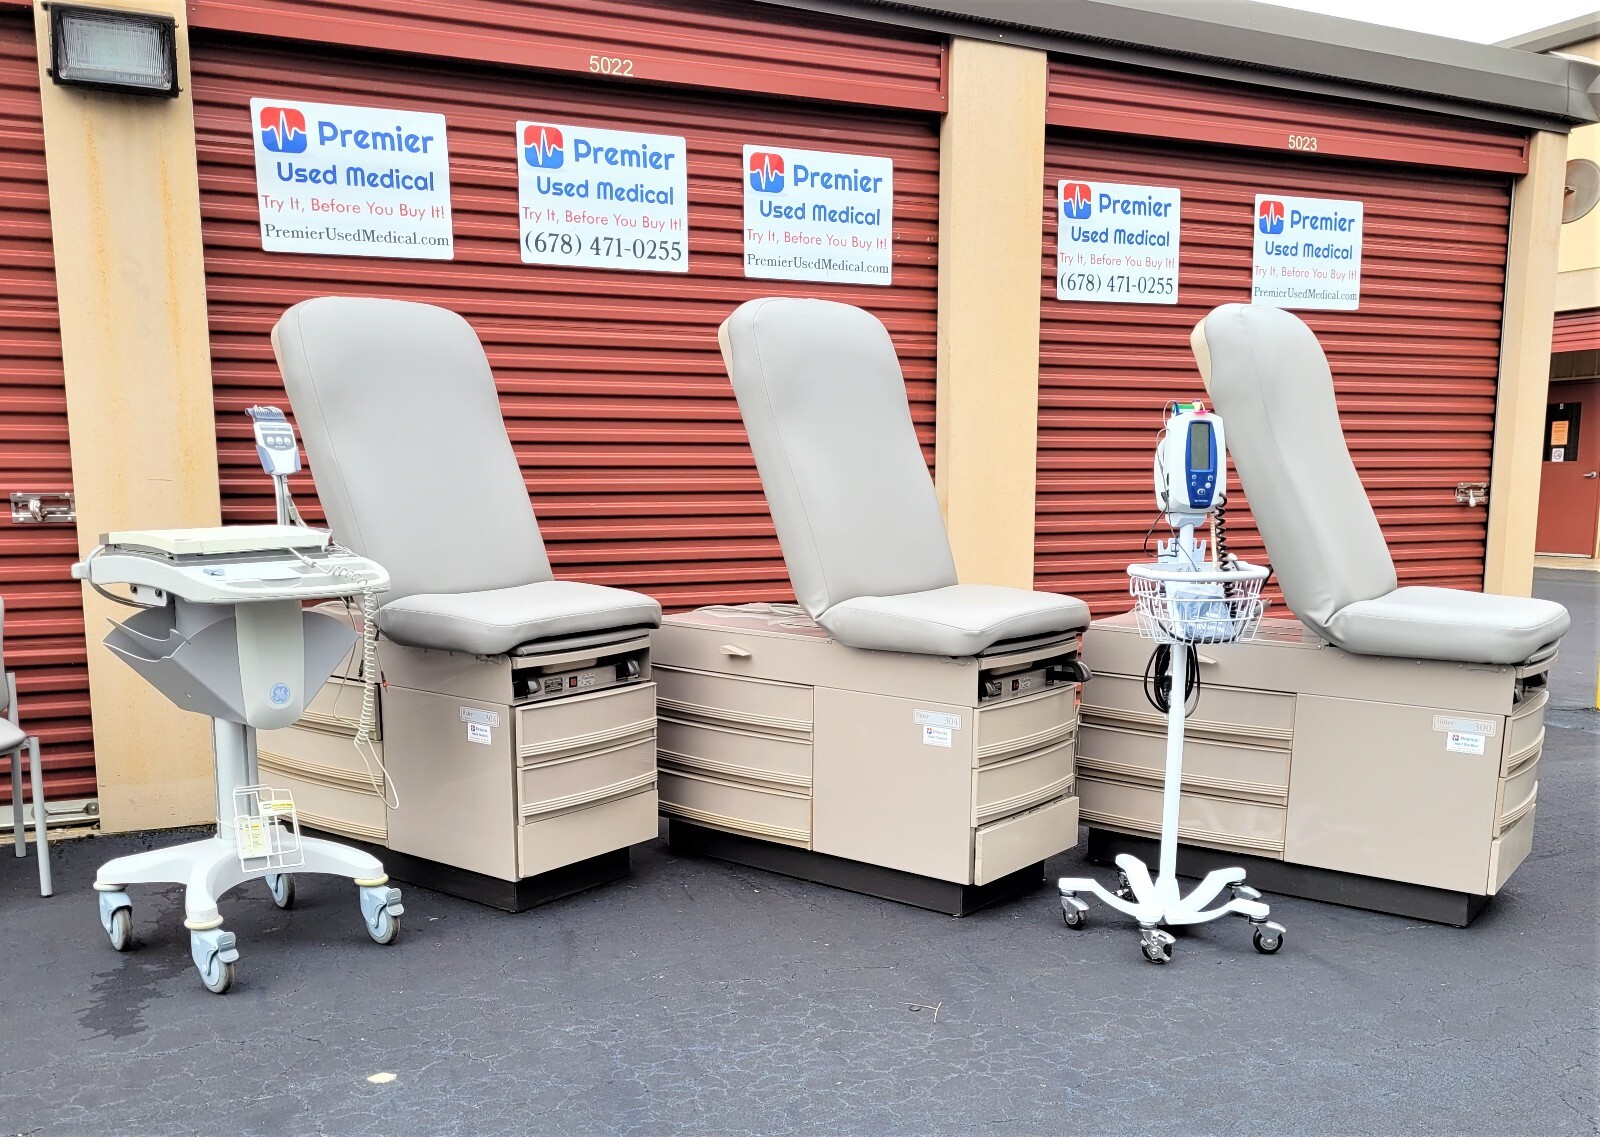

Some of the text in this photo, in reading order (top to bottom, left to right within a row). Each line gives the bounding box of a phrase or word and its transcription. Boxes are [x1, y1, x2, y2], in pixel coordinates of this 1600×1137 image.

[589, 54, 634, 77] 5022
[318, 121, 433, 153] Premier
[1288, 134, 1318, 151] 5023
[574, 138, 675, 170] Premier
[277, 162, 434, 191] Used Medical
[794, 164, 882, 193] Premier
[537, 176, 674, 205] Used Medical
[261, 195, 445, 221] Try It, Before You Buy It!
[760, 200, 880, 226] Used Medical
[1099, 193, 1172, 217] Premier
[522, 207, 682, 231] Try It, Before You Buy It!
[1291, 210, 1355, 232] Premier
[264, 224, 449, 246] PremierUsedMedical.com
[525, 231, 682, 261] (678) 471-0255
[747, 229, 887, 251] Try It, Before You Buy It!
[1071, 226, 1169, 247] Used Medical
[1266, 241, 1352, 259] Used Medical
[747, 254, 889, 274] PremierUsedMedical.com
[1060, 253, 1073, 266] Try
[1091, 254, 1121, 265] Before
[1125, 256, 1141, 267] You
[1146, 257, 1162, 270] Buy
[1061, 272, 1173, 294] (678) 471-0255
[1255, 265, 1267, 278] Try
[1282, 267, 1309, 277] Before
[1313, 268, 1327, 278] You
[1331, 269, 1346, 281] Buy
[1254, 287, 1357, 300] PremierUsedMedical.com
[1474, 723, 1491, 732] 300
